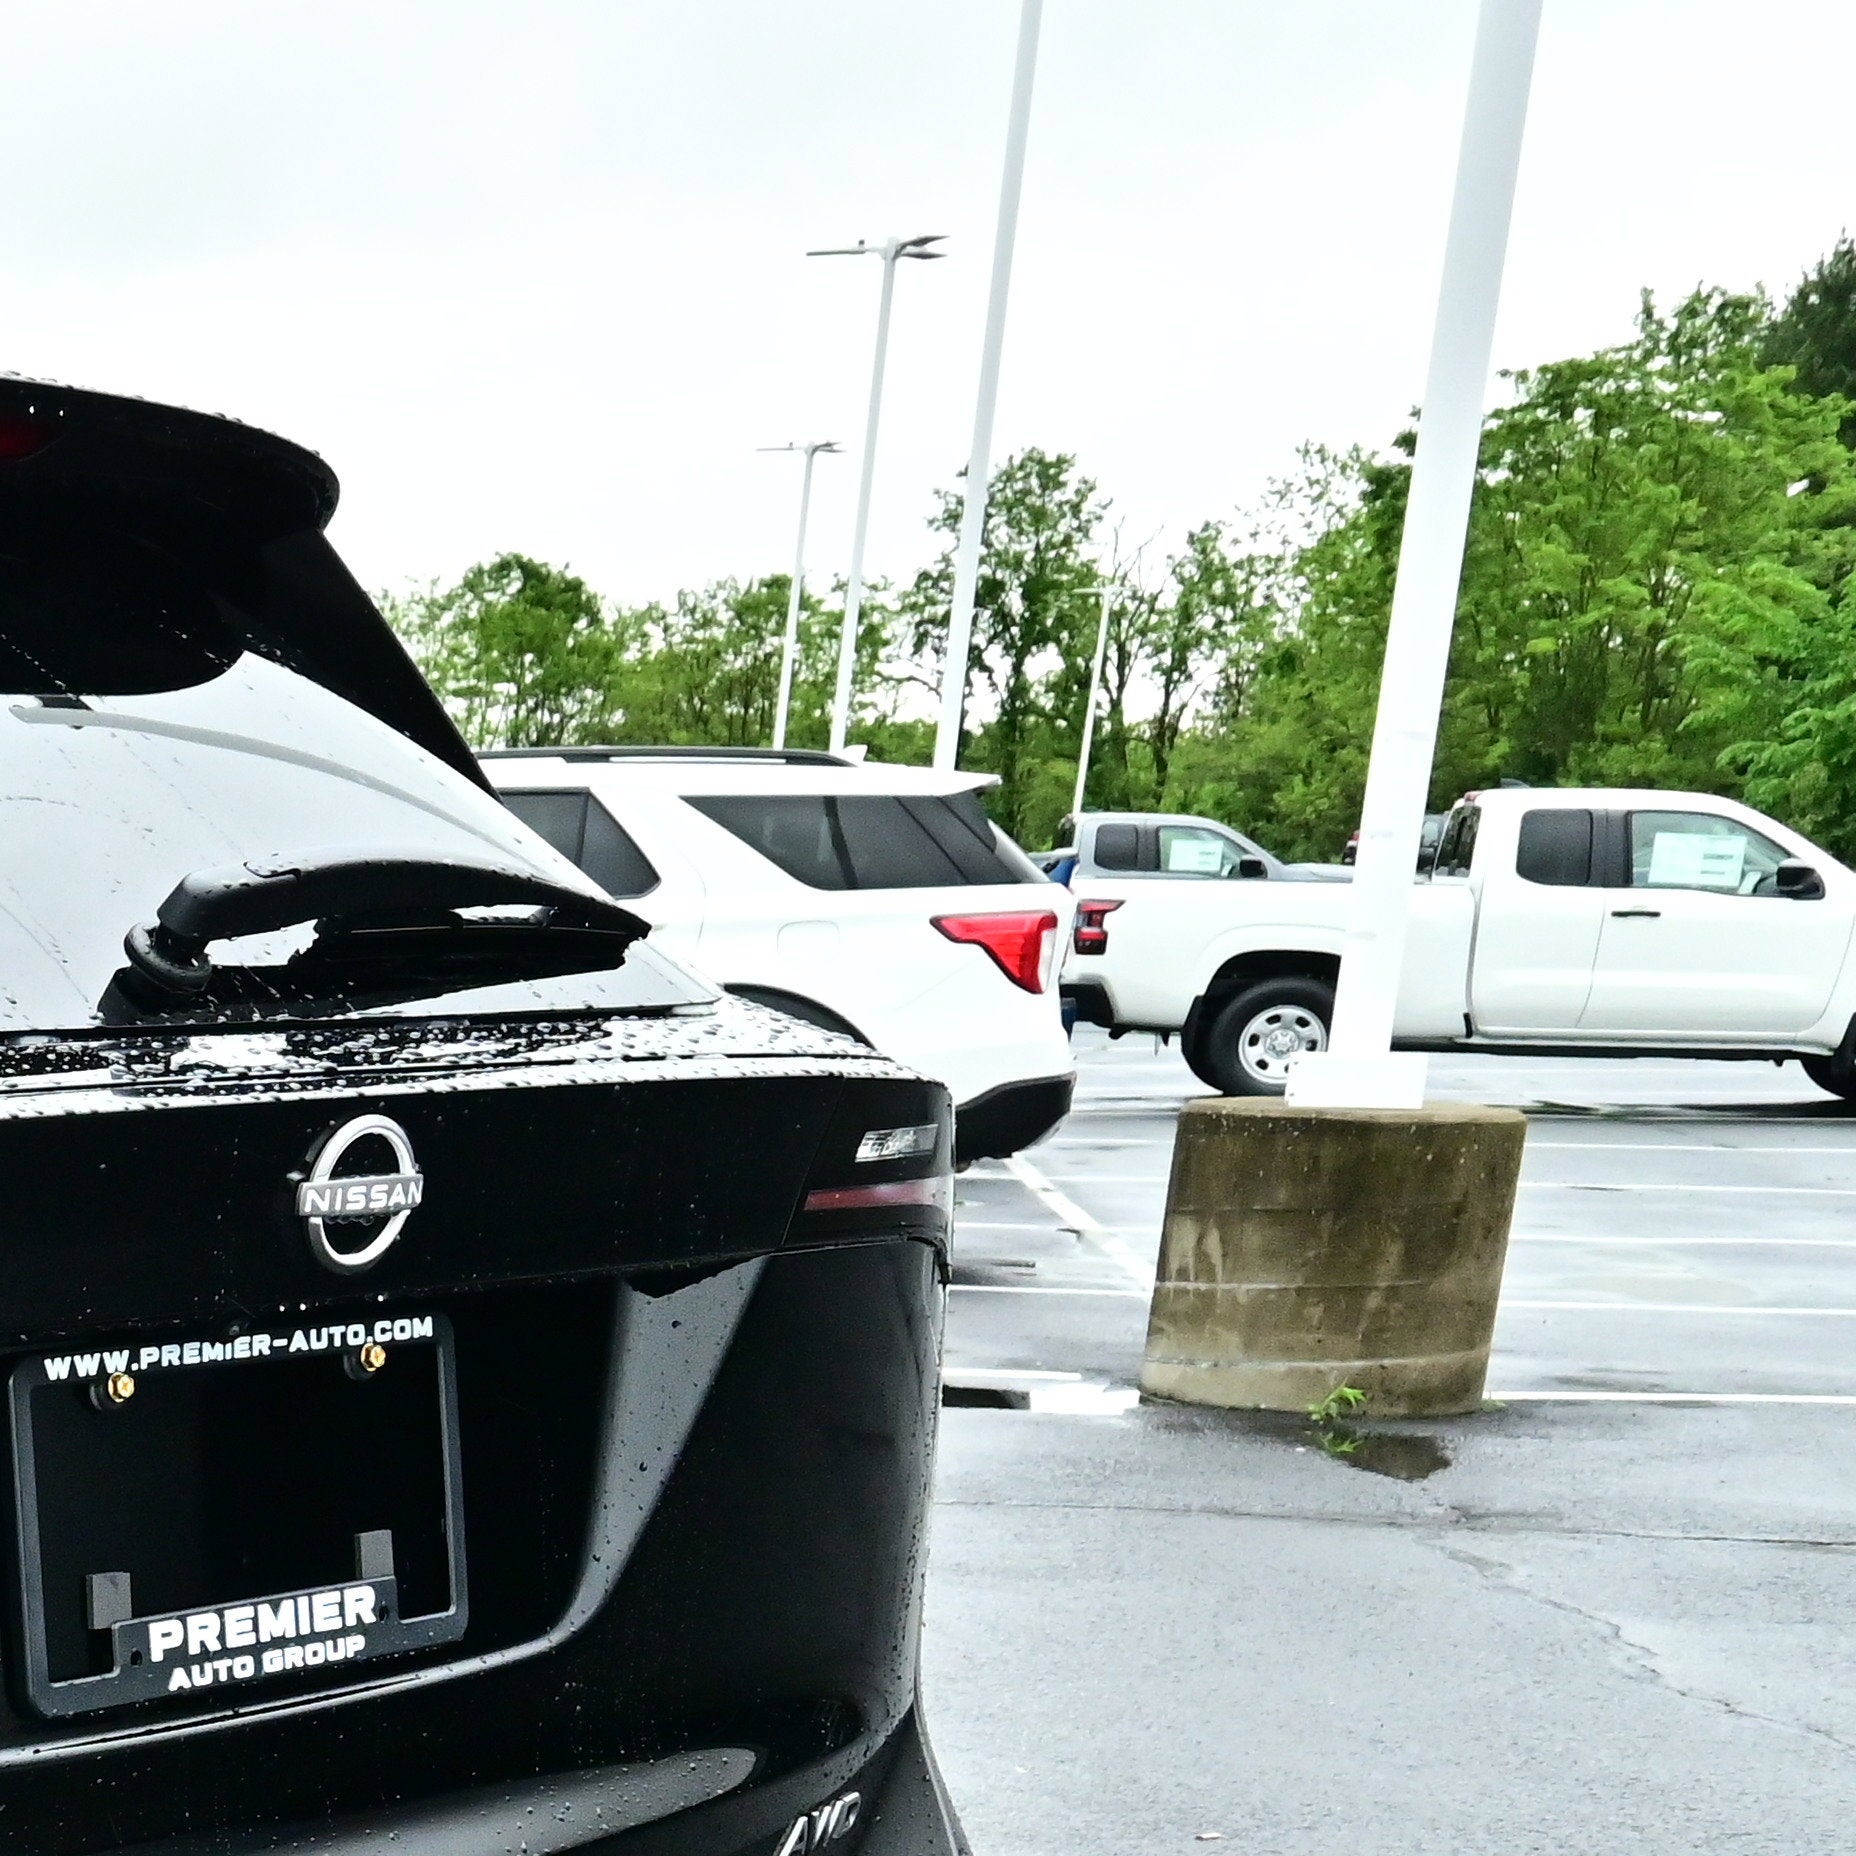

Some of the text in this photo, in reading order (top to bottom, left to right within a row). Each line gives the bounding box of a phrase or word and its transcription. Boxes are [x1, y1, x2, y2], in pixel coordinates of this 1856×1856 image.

[304, 1180, 423, 1213] NISSAN
[43, 1316, 433, 1381] WWW.PREMIER-AUTO.COM
[148, 1584, 377, 1663] PREMIER
[168, 1634, 366, 1692] AUTO GROUP
